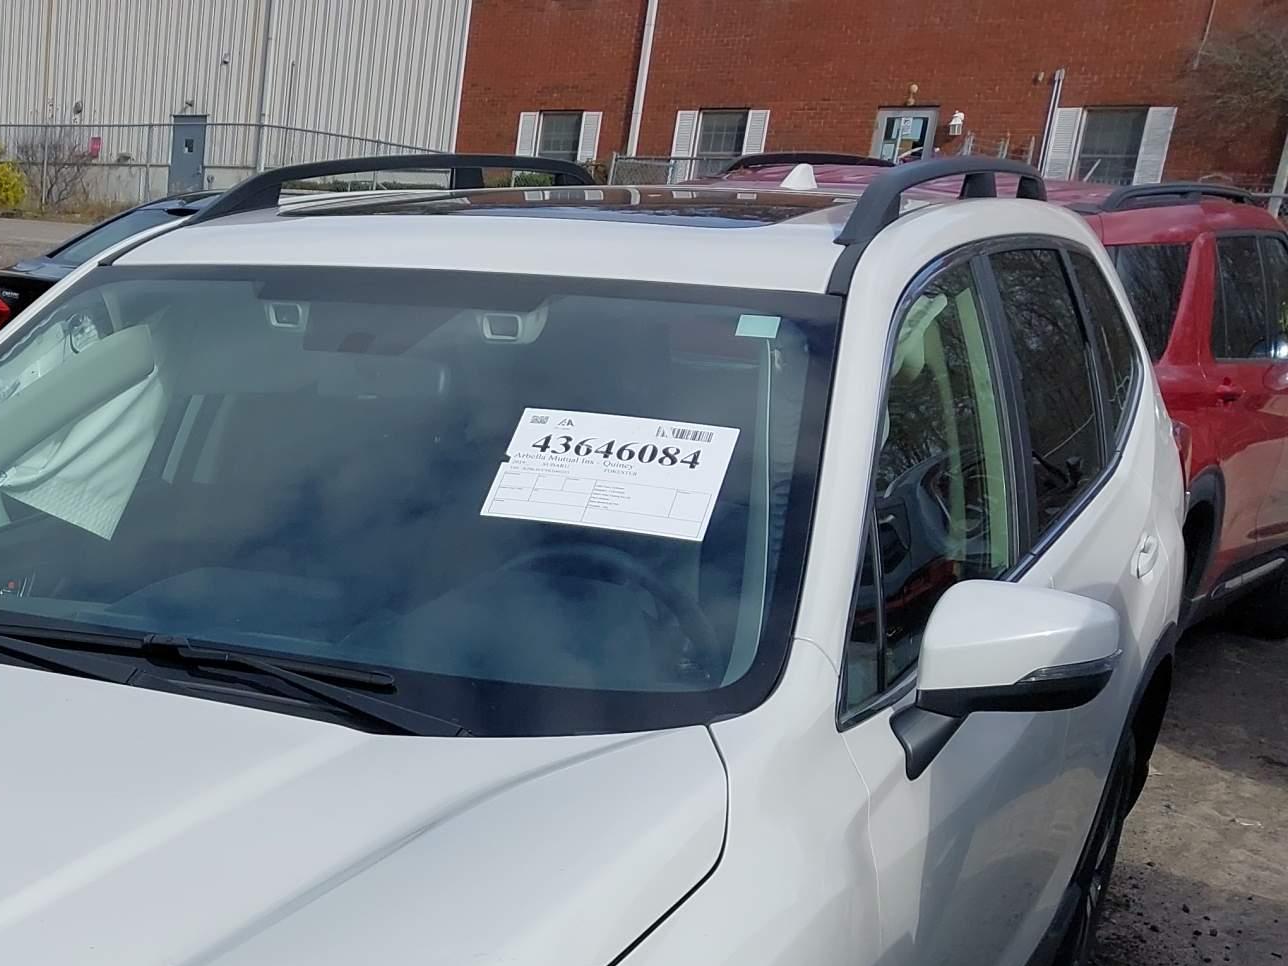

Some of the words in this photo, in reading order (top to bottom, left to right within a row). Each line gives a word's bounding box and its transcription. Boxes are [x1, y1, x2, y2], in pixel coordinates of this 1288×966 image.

[531, 433, 702, 470] 43646084
[548, 455, 579, 465] Mutual
[602, 459, 633, 471] Quincy
